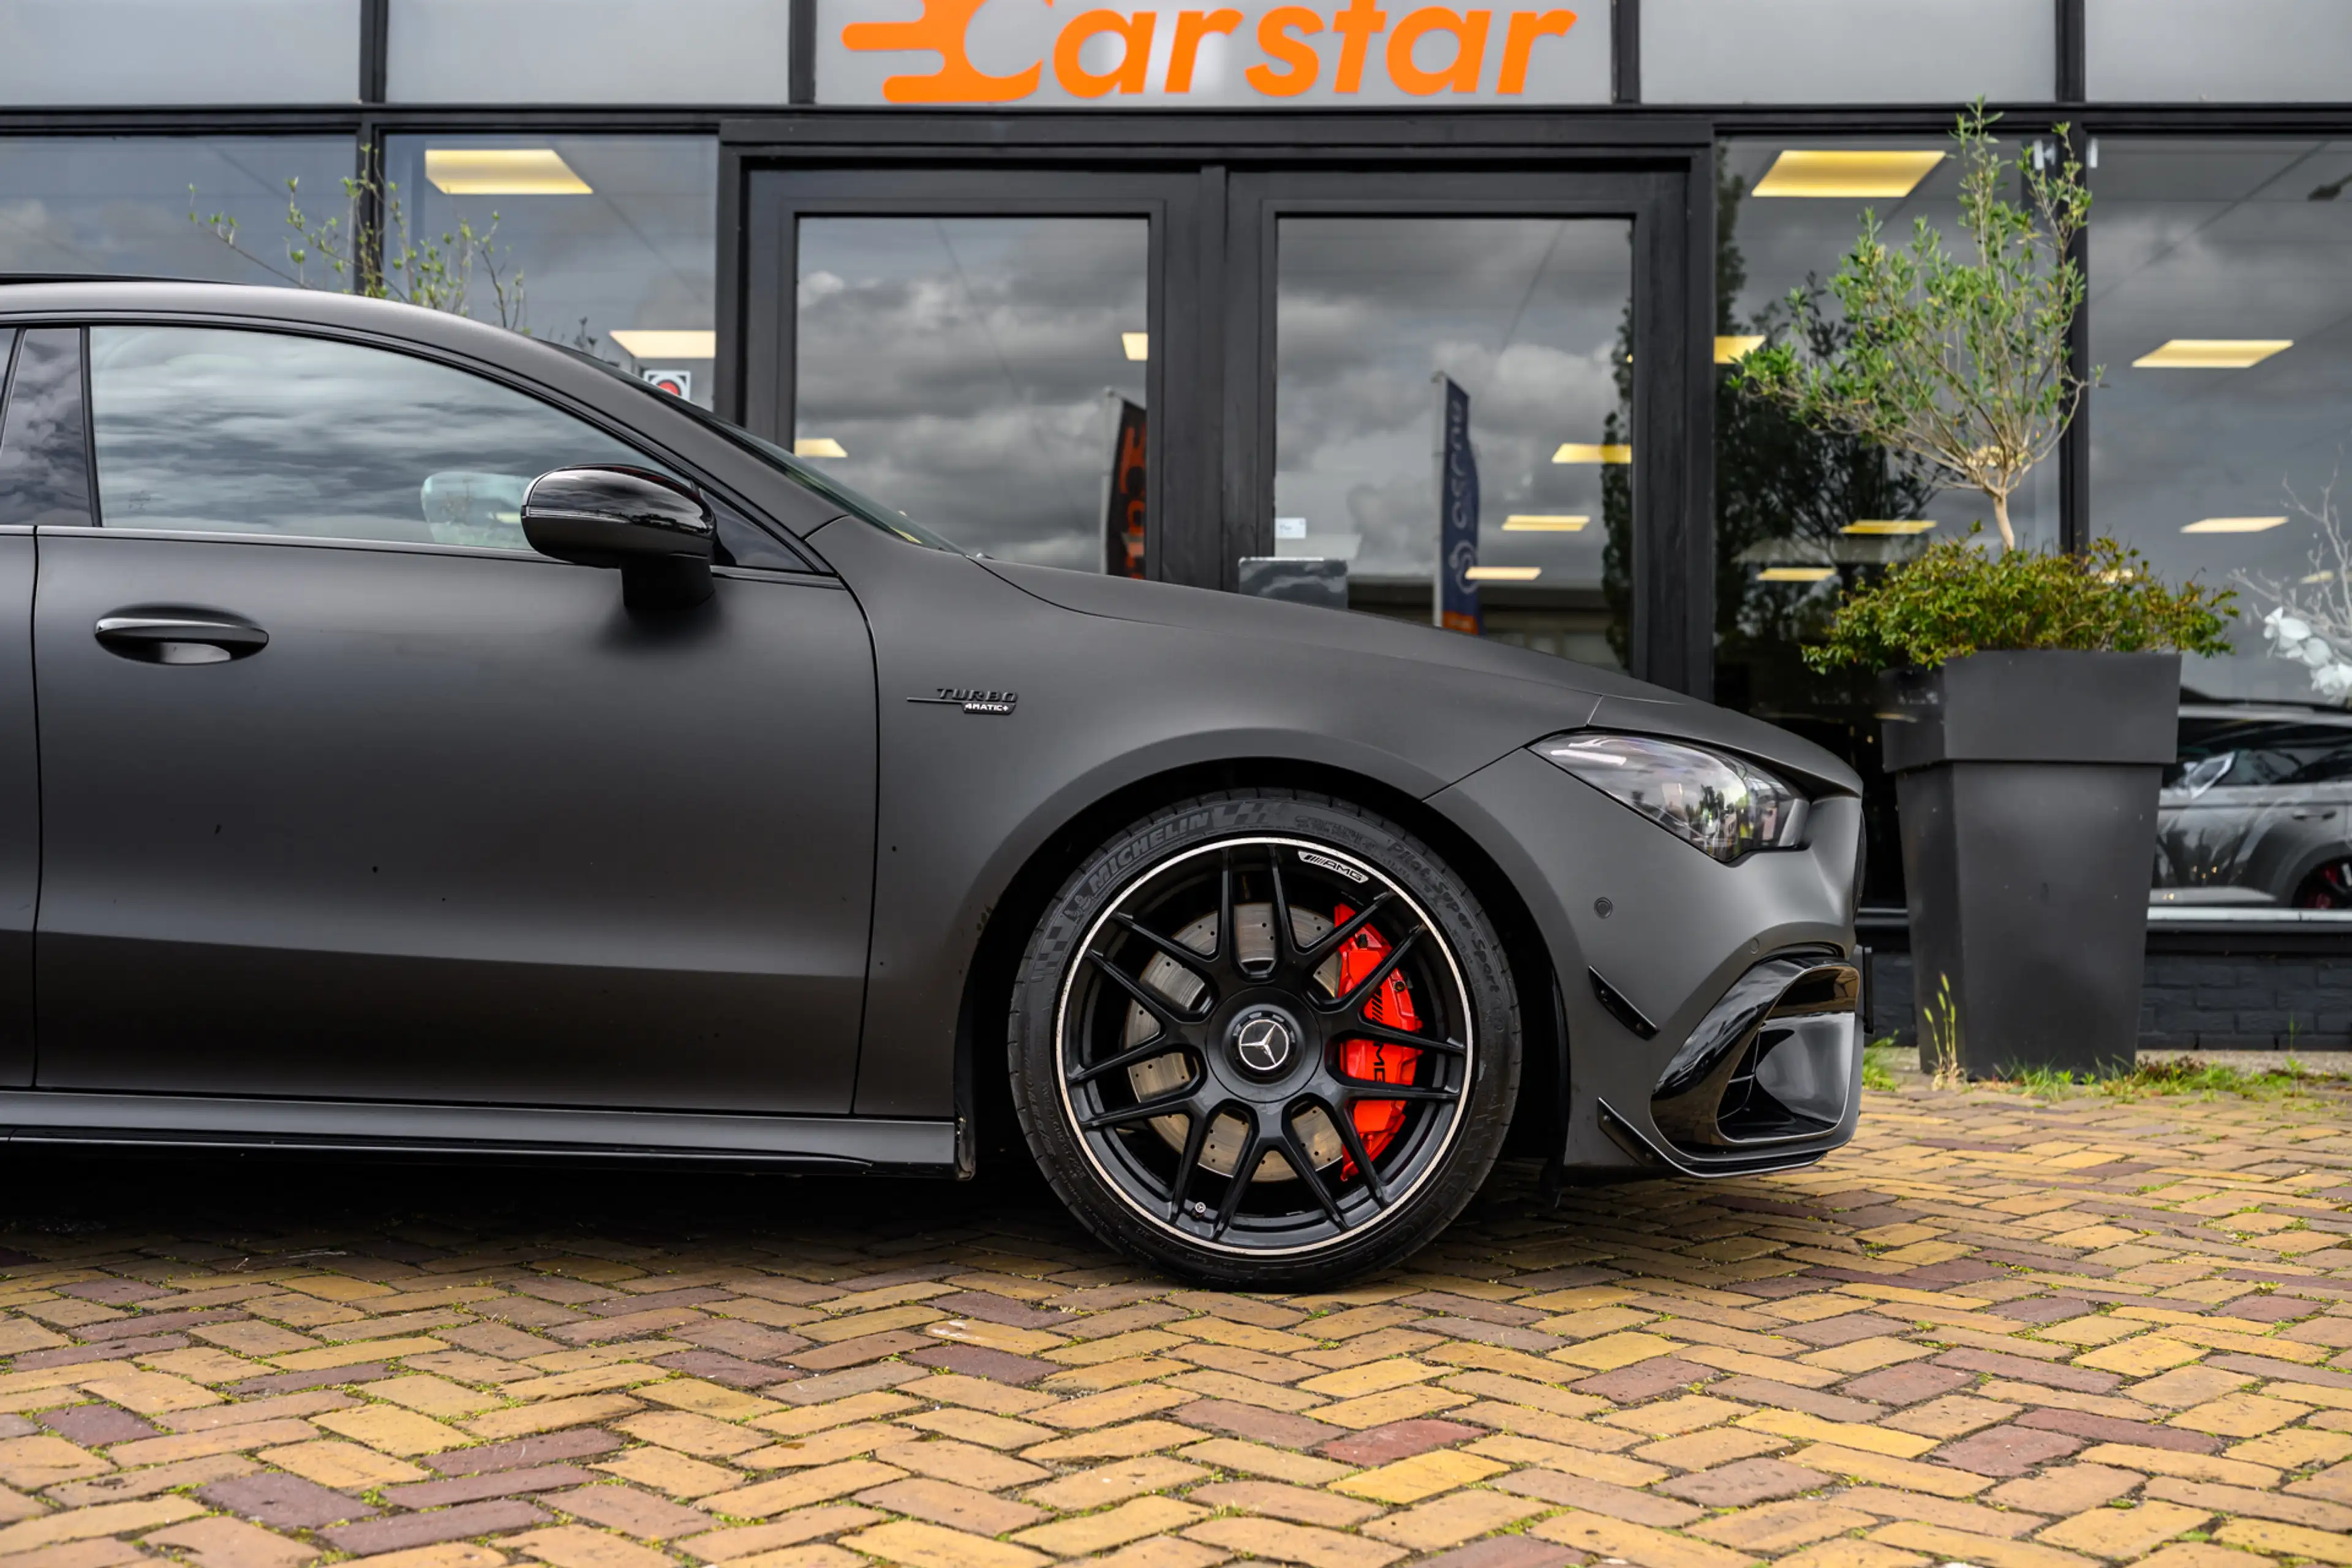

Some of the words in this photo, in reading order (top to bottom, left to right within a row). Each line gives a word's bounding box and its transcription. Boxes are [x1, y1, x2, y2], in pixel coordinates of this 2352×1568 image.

[841, 0, 1578, 103] Carstar
[937, 688, 1018, 703] TURBO
[963, 703, 1009, 711] 4MATIC+
[1088, 812, 1209, 894] MICHELIN
[1322, 859, 1363, 881] AMG
[1373, 1041, 1385, 1082] MG
